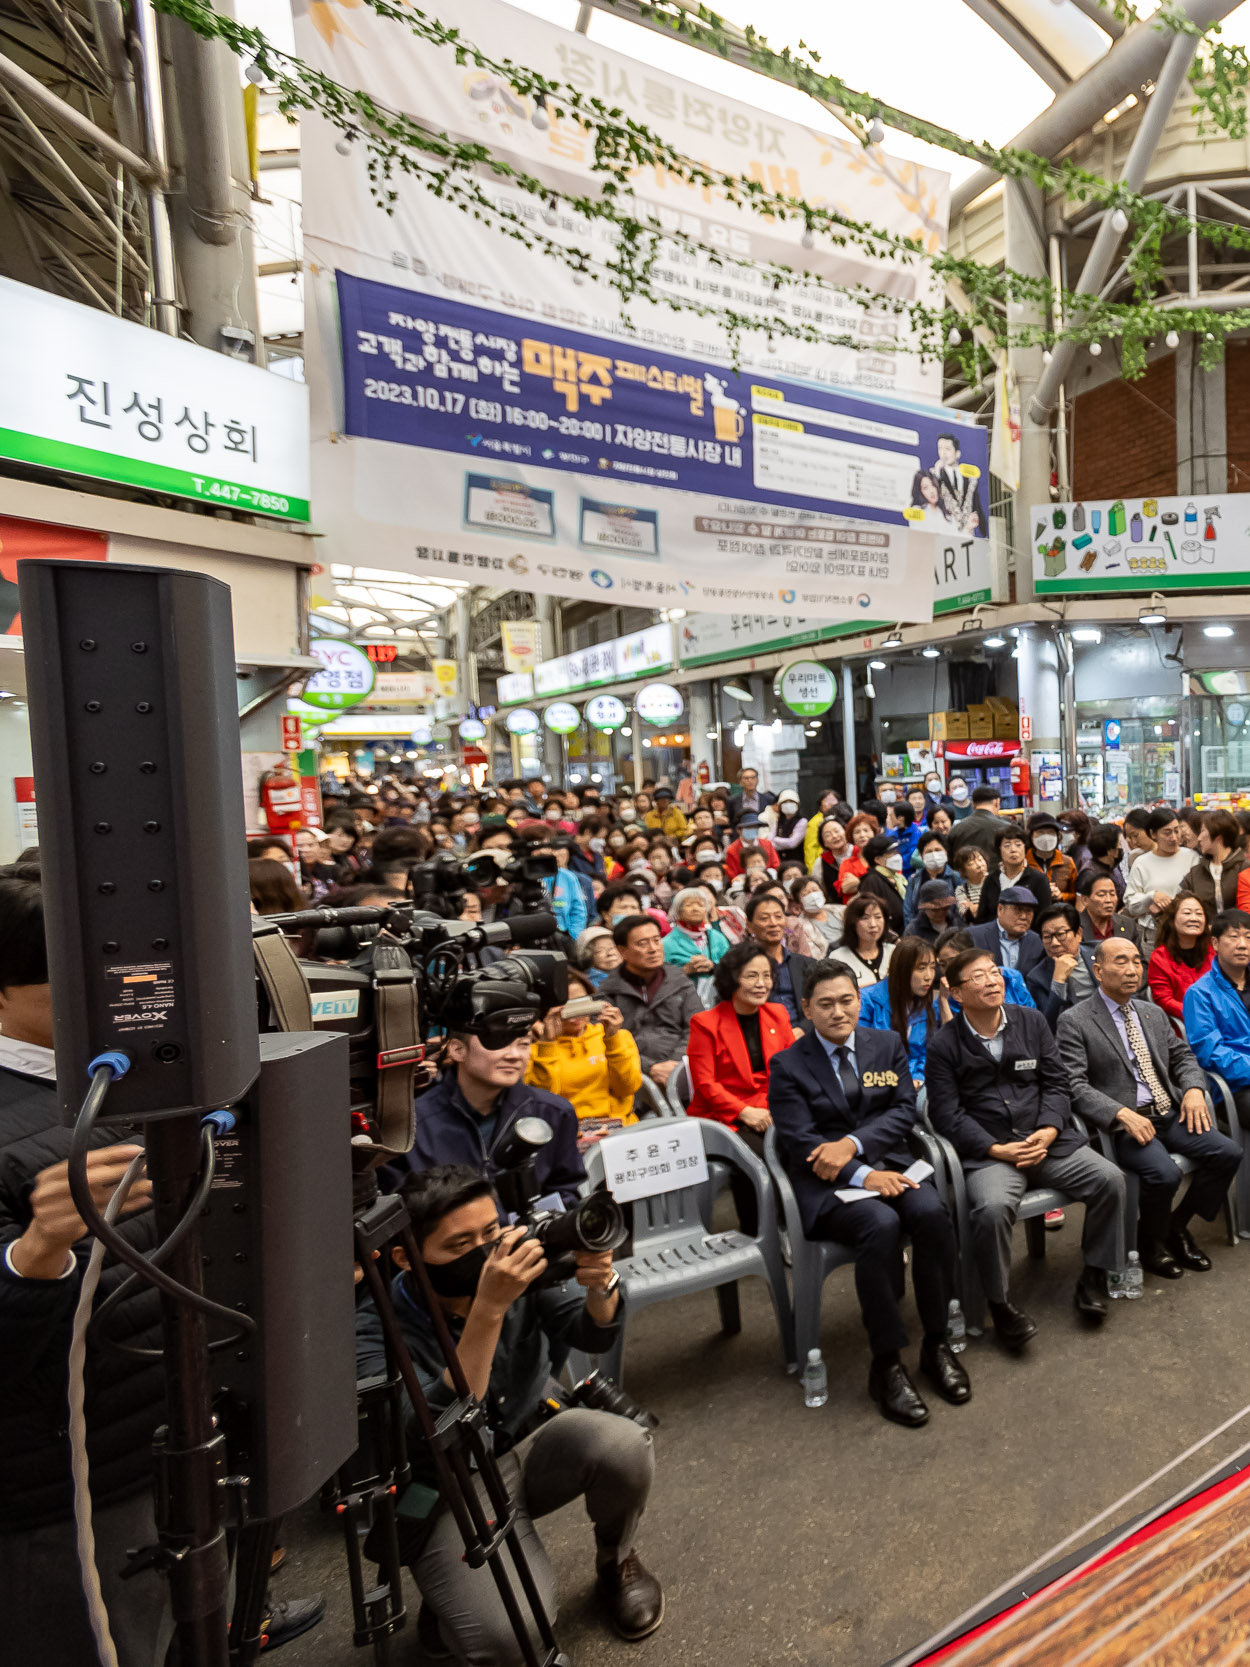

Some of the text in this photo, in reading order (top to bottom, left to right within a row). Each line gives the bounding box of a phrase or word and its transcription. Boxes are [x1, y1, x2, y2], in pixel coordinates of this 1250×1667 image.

[521, 338, 705, 417] 맥주 페스티벌
[65, 372, 259, 464] 진성상회
[364, 378, 465, 415] 2023.10.17
[469, 397, 502, 424] (화)
[614, 423, 722, 464] 자양전통시장
[725, 444, 742, 469] 내
[192, 477, 290, 514] T.447-7850
[788, 672, 827, 685] 우리마트
[966, 742, 1004, 757] Coca-Cola
